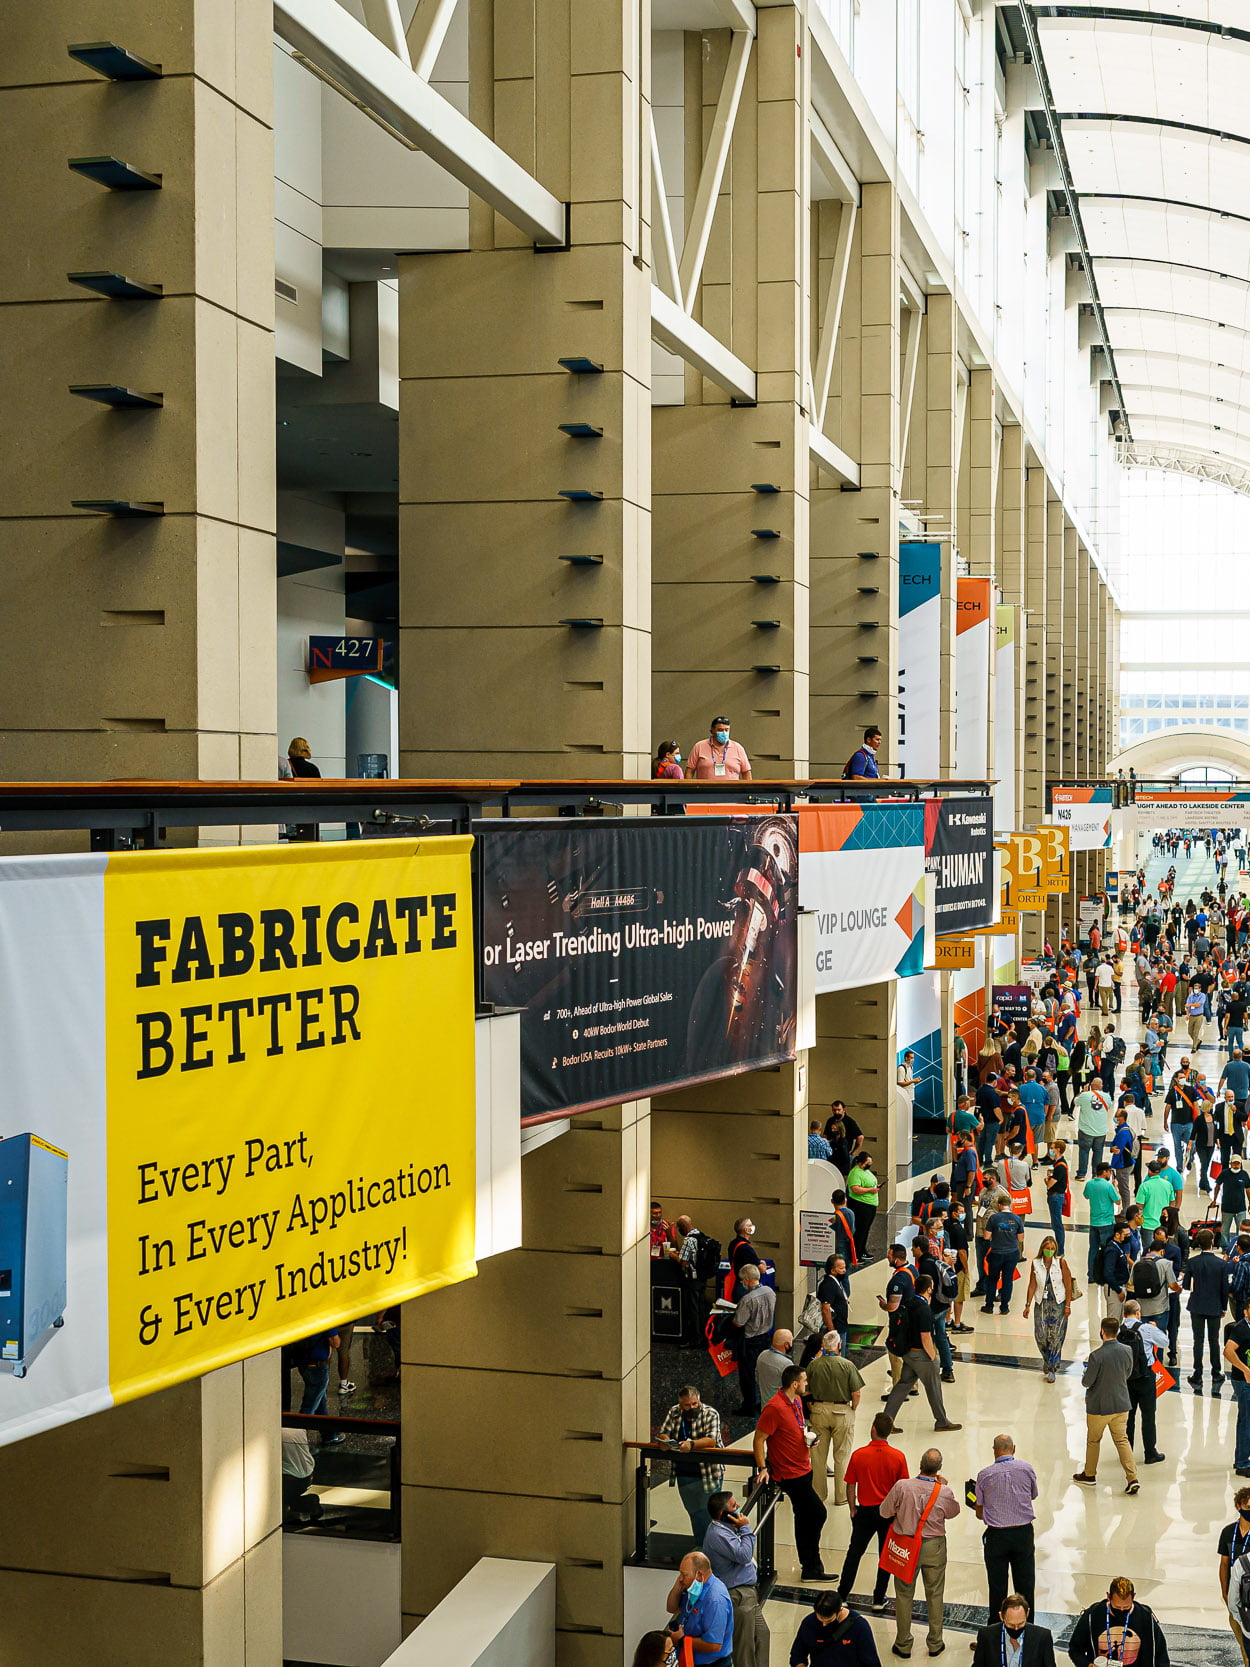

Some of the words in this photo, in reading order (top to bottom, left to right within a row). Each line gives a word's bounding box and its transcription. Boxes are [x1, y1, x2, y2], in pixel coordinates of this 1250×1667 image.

[962, 812, 986, 824] Kawasaki
[1058, 809, 1072, 820] N426
[818, 914, 838, 935] VIP
[840, 907, 887, 932] LOUNGE
[135, 893, 458, 988] FABRICATE
[506, 932, 550, 964] Laser
[553, 926, 621, 958] Trending
[625, 918, 693, 950] Ultra-high
[696, 917, 735, 942] Power
[574, 1005, 592, 1017] Ahead
[593, 1004, 599, 1014] of
[599, 1000, 625, 1013] Ultra-high
[626, 997, 642, 1009] Power
[643, 993, 659, 1006] Global
[660, 992, 673, 1003] Sales
[136, 984, 362, 1080] BETTER
[616, 1021, 632, 1033] World
[633, 1018, 649, 1030] Debut
[562, 1054, 580, 1067] Bodor
[580, 1052, 592, 1064] USA
[633, 1042, 646, 1052] State
[647, 1038, 668, 1049] Partners
[138, 1153, 236, 1205] Every
[245, 1130, 314, 1178] Part,
[138, 1233, 176, 1277] In
[187, 1209, 281, 1262] Every
[287, 1161, 452, 1240] Application
[138, 1304, 164, 1346] &
[172, 1280, 268, 1337] Every
[275, 1225, 410, 1304] Industry!
[888, 1539, 910, 1560] Mazak
